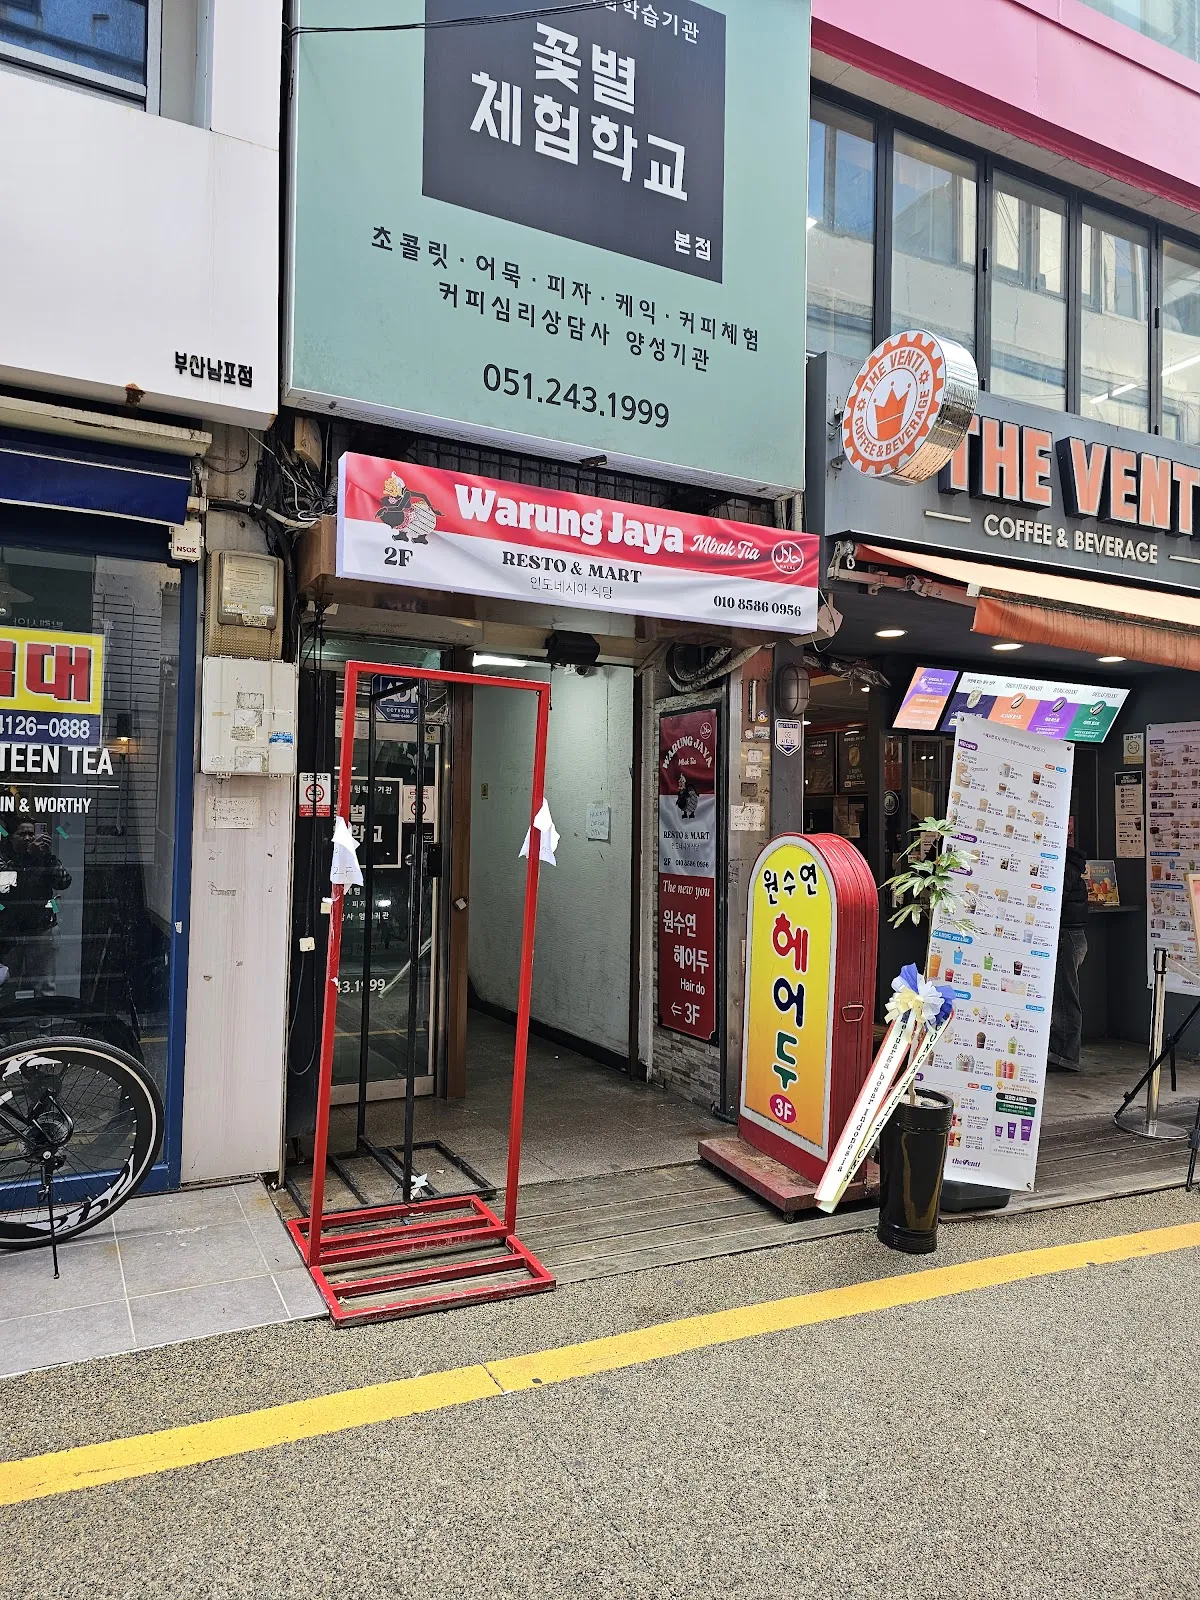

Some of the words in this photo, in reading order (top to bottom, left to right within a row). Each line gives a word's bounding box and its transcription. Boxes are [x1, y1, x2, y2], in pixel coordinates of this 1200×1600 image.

[533, 22, 636, 115] 꽃별
[470, 71, 688, 202] 체험학교
[674, 230, 712, 262] 본점
[371, 226, 449, 270] 초콜릿
[475, 255, 521, 284] 어묵
[547, 274, 592, 306] 피자
[615, 292, 656, 325] 케익
[679, 309, 759, 352] 커피체험
[438, 283, 609, 346] 커피심리상담사
[626, 331, 710, 373] 양성기관
[174, 351, 254, 388] 부산남포점
[863, 362, 887, 393] THE
[890, 350, 925, 372] VENTI
[483, 363, 670, 429] 051.243.1999
[854, 417, 874, 457] COFFEE
[877, 446, 884, 457] &
[886, 389, 930, 455] BEVERAGE
[947, 415, 1052, 510] THE
[454, 484, 603, 546] Warung
[607, 511, 684, 554] Jaya
[689, 533, 737, 560] Mbak
[734, 539, 761, 561] Tia
[984, 514, 1052, 546] COFFEE
[1056, 530, 1069, 549] &
[1074, 531, 1159, 564] BEVERAGE
[384, 546, 414, 568] 2F
[502, 551, 567, 574] RESTO
[570, 562, 584, 577] &
[589, 564, 642, 584] MART
[530, 576, 589, 597] 인도네시아
[592, 583, 613, 600] 식당
[713, 594, 736, 611] 010
[738, 597, 769, 614] 8586
[771, 599, 802, 617] 0956
[0, 743, 60, 773] TEEN
[67, 745, 114, 775] TEA
[662, 736, 694, 769] WARUNG
[693, 738, 712, 769] JAYA
[18, 797, 30, 813] &
[34, 796, 92, 814] WORTHY
[664, 831, 683, 839] RESTO
[690, 832, 709, 840] MART
[663, 858, 671, 866] 2F
[663, 880, 676, 893] The
[677, 885, 694, 895] new
[695, 886, 711, 900] you
[763, 864, 817, 905] 원수연
[663, 910, 697, 938] 원수연
[674, 945, 709, 975] 헤어두
[684, 1002, 700, 1025] 3F
[772, 912, 808, 1090] 헤어두
[884, 1020, 907, 1069] eluarga
[774, 1098, 793, 1122] 3F
